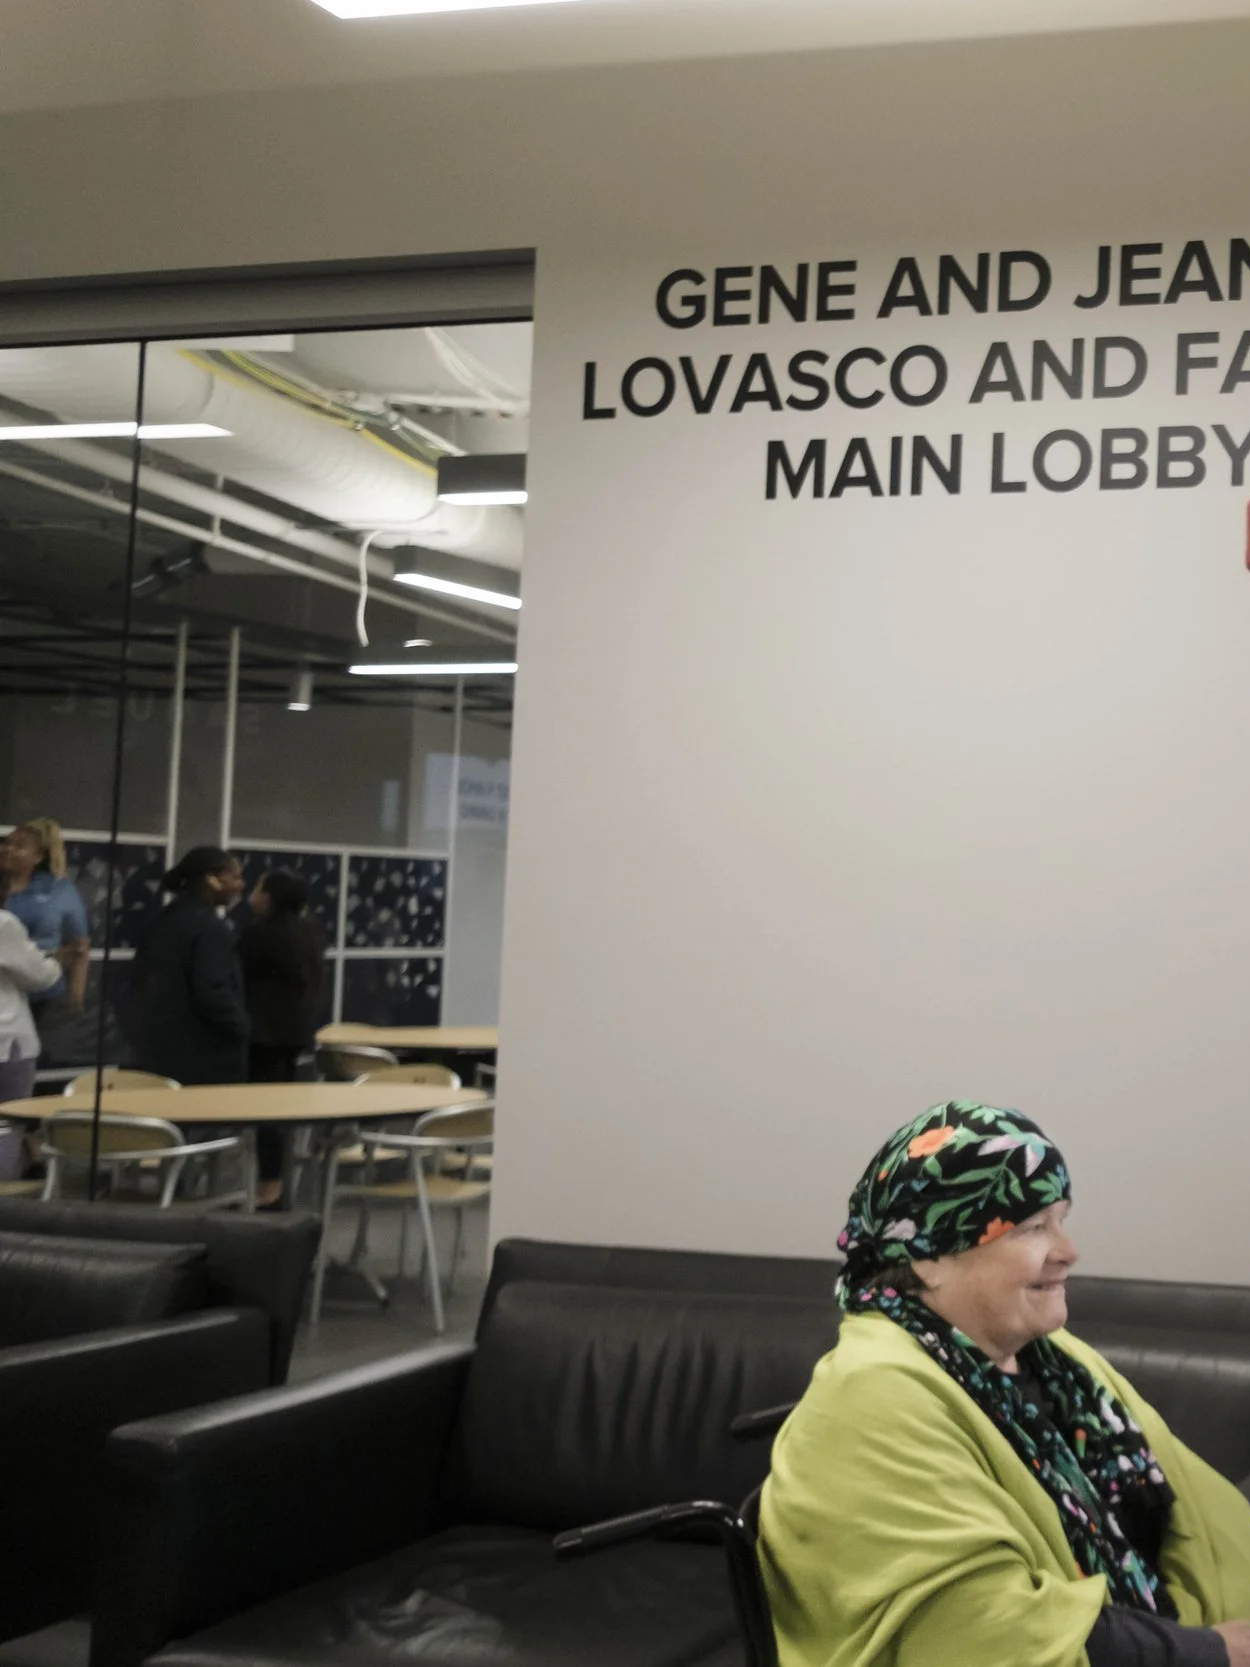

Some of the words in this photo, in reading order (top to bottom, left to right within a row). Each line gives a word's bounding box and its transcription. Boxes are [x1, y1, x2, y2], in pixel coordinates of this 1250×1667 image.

[654, 256, 858, 329] GENE
[876, 249, 1053, 320] AND
[582, 344, 949, 420] LOVASCO
[968, 331, 1149, 405] AND
[764, 433, 964, 500] MAIN
